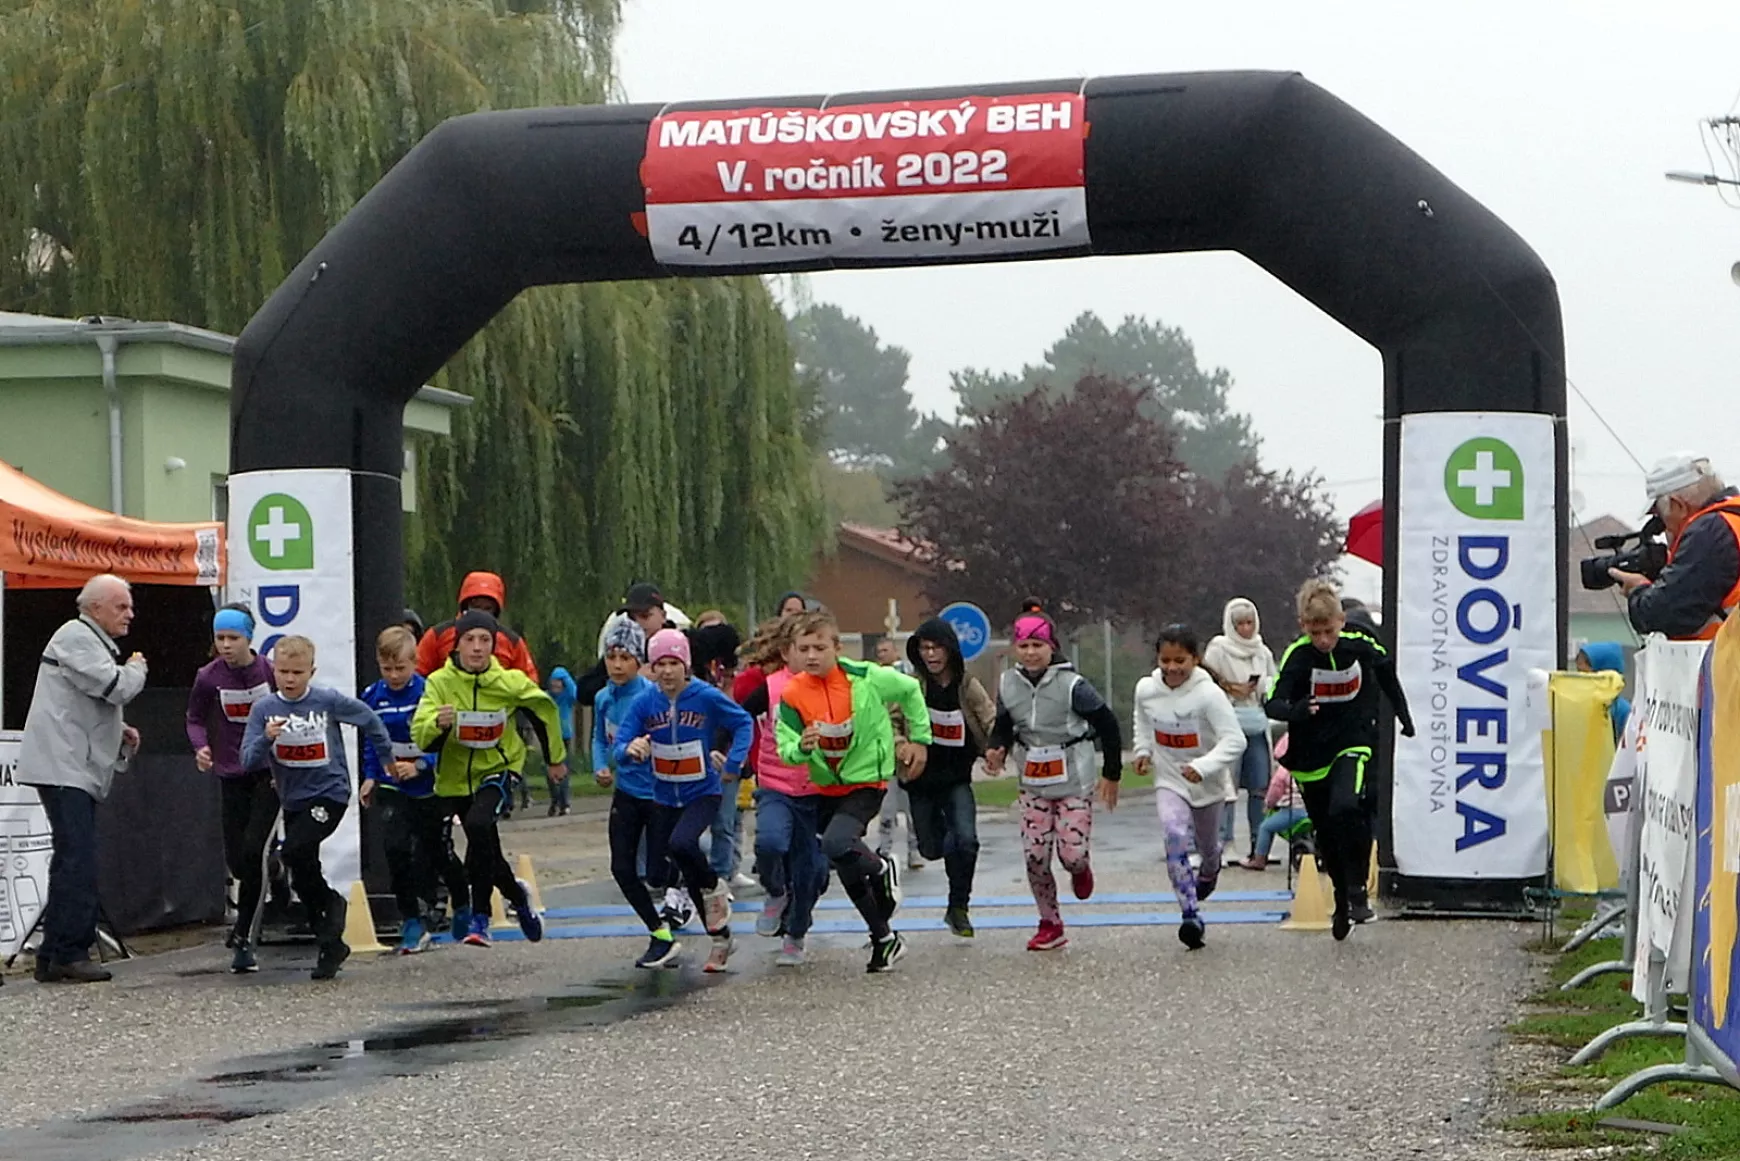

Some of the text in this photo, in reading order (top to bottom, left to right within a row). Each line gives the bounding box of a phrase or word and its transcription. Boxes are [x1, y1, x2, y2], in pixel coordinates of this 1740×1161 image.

[659, 101, 1072, 147] MATÚŠKOVSKÝ BEH
[716, 150, 1008, 193] V. ročník 2022
[677, 211, 1061, 255] 4/12km ženy-muži
[1430, 536, 1451, 813] ZDRAVOTNÁ POISŤOVŇA
[668, 759, 681, 774] 7
[1031, 760, 1051, 777] 24
